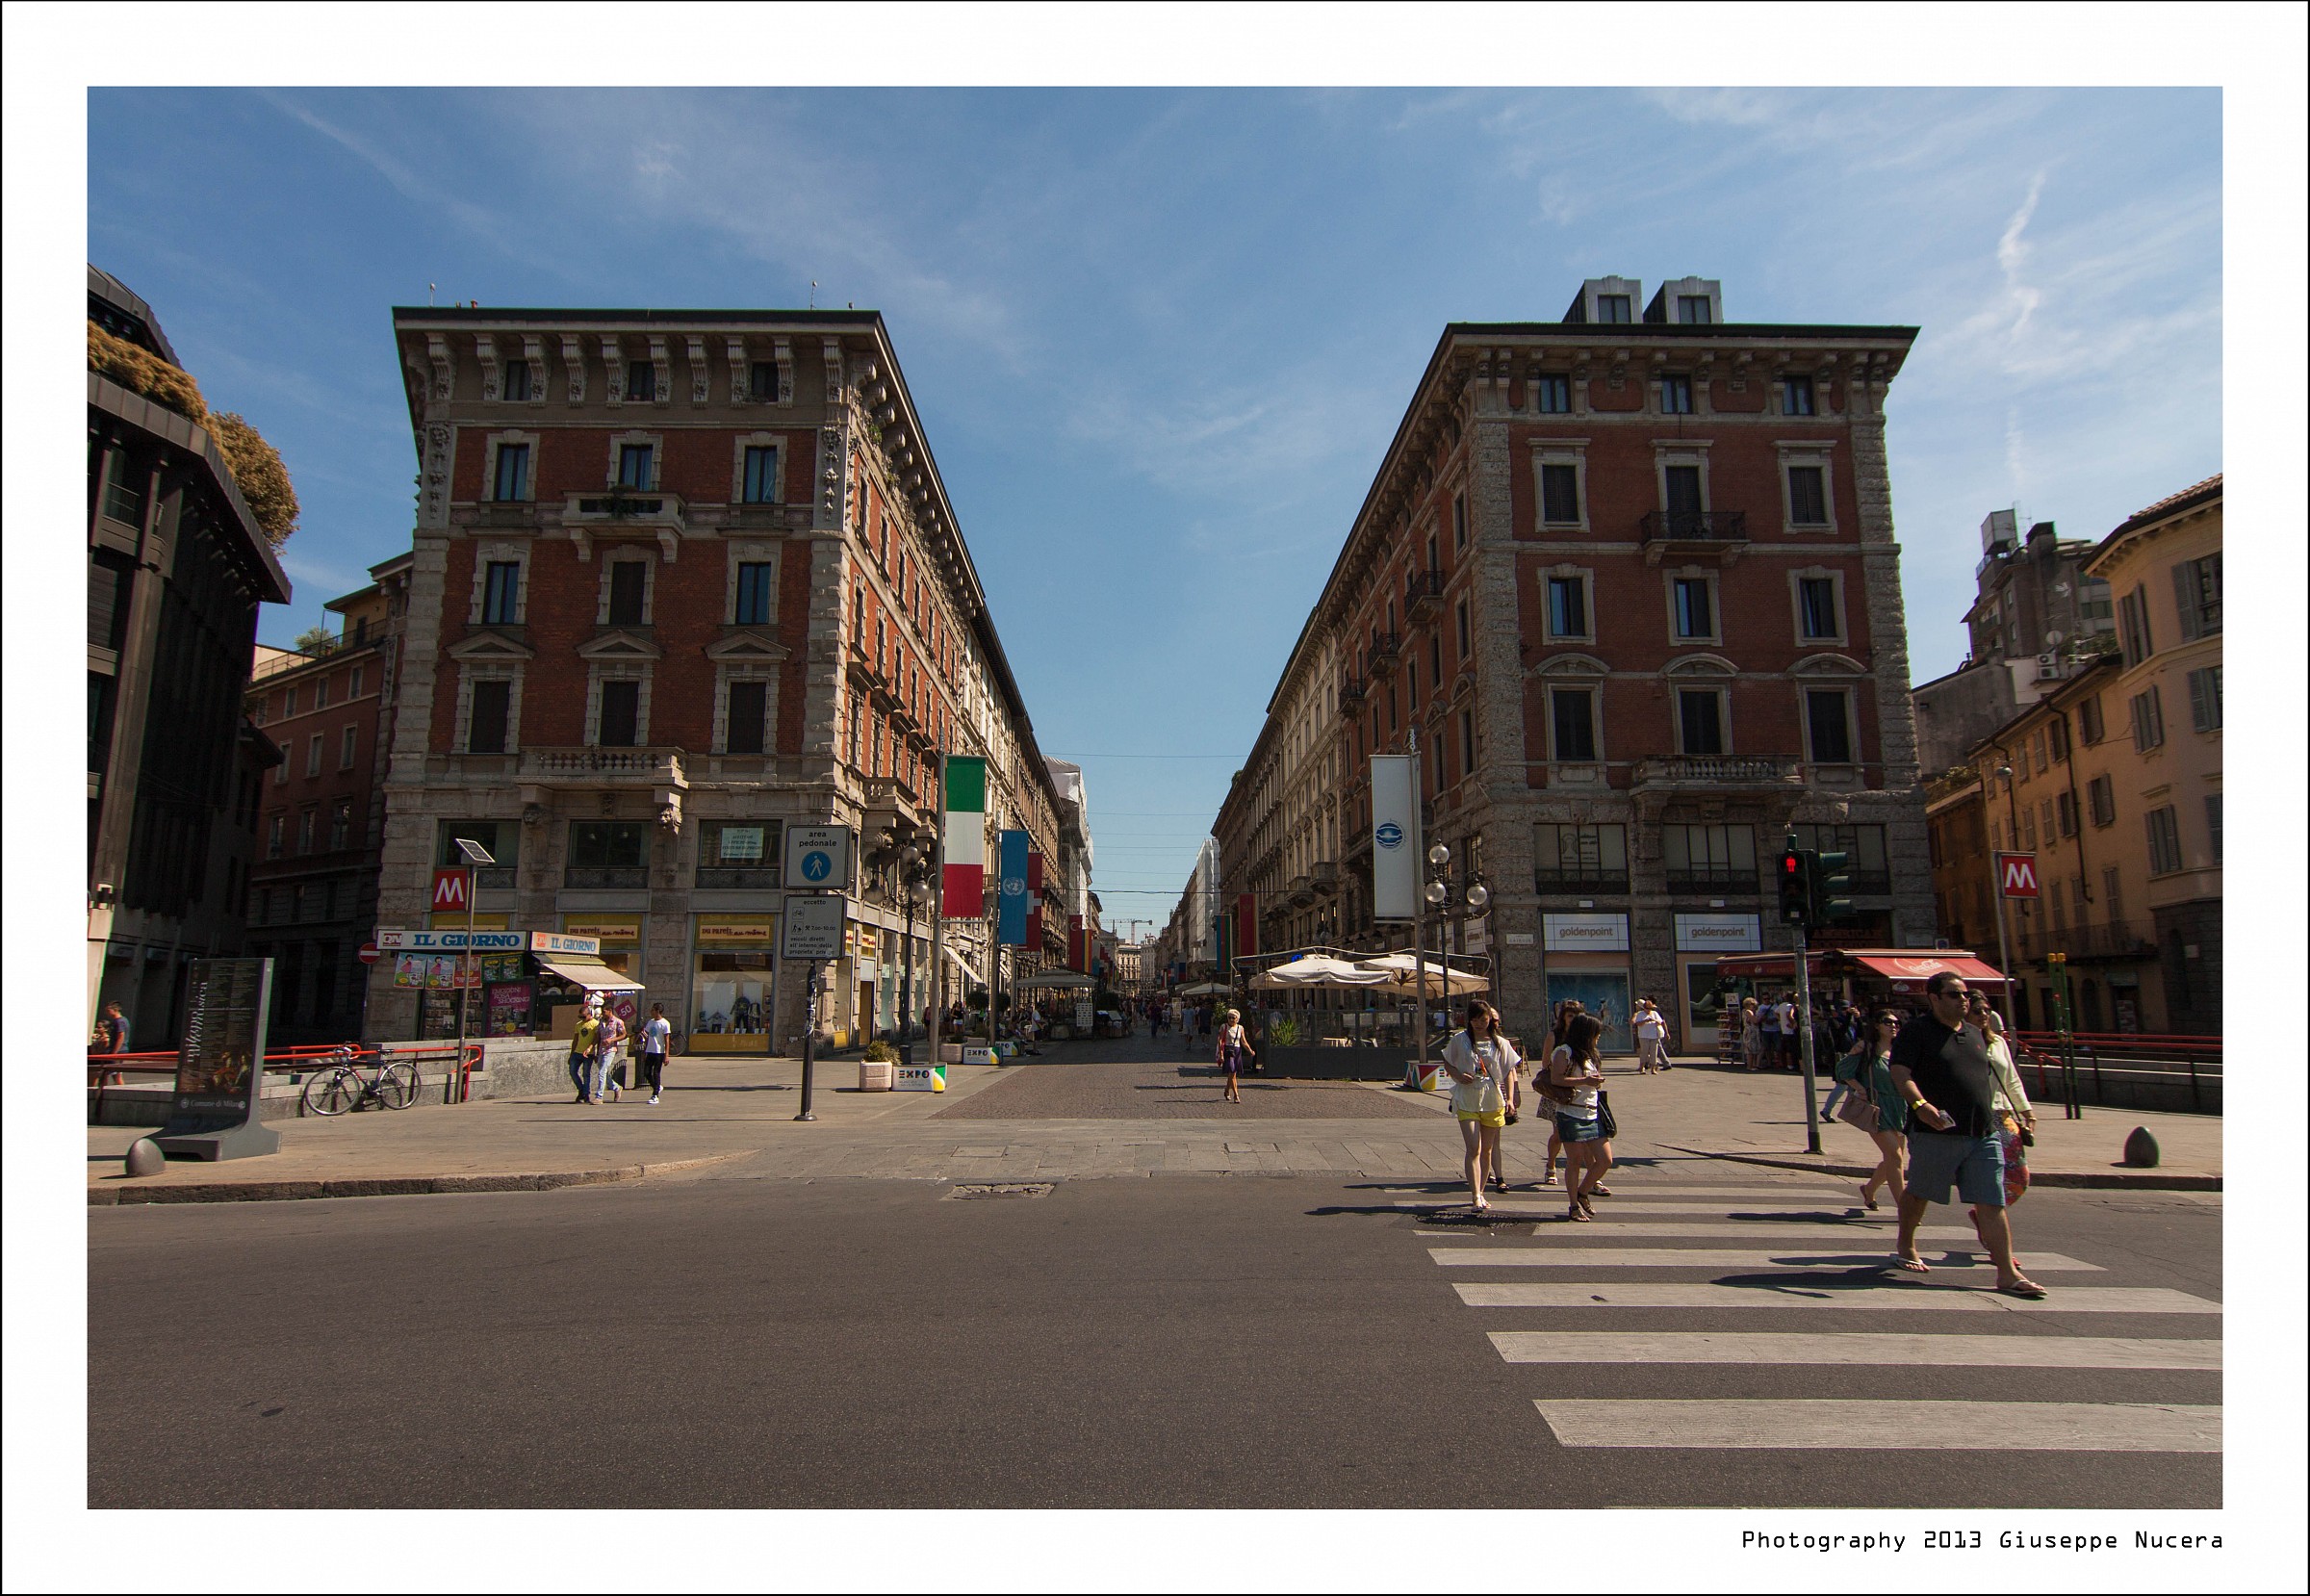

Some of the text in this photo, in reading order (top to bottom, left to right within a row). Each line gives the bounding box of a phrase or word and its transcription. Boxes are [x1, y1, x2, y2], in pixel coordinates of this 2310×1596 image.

[799, 839, 837, 848] pedonale
[2005, 862, 2037, 888] M
[435, 877, 464, 903] M
[384, 935, 402, 943] QN
[1559, 926, 1613, 939] goldenpoint
[1691, 926, 1745, 939] goldenpoint
[414, 934, 436, 946] IL
[441, 934, 521, 947] GIORNO
[552, 937, 562, 949] IL
[563, 939, 597, 952] GIORNO
[898, 1069, 930, 1079] EXPO
